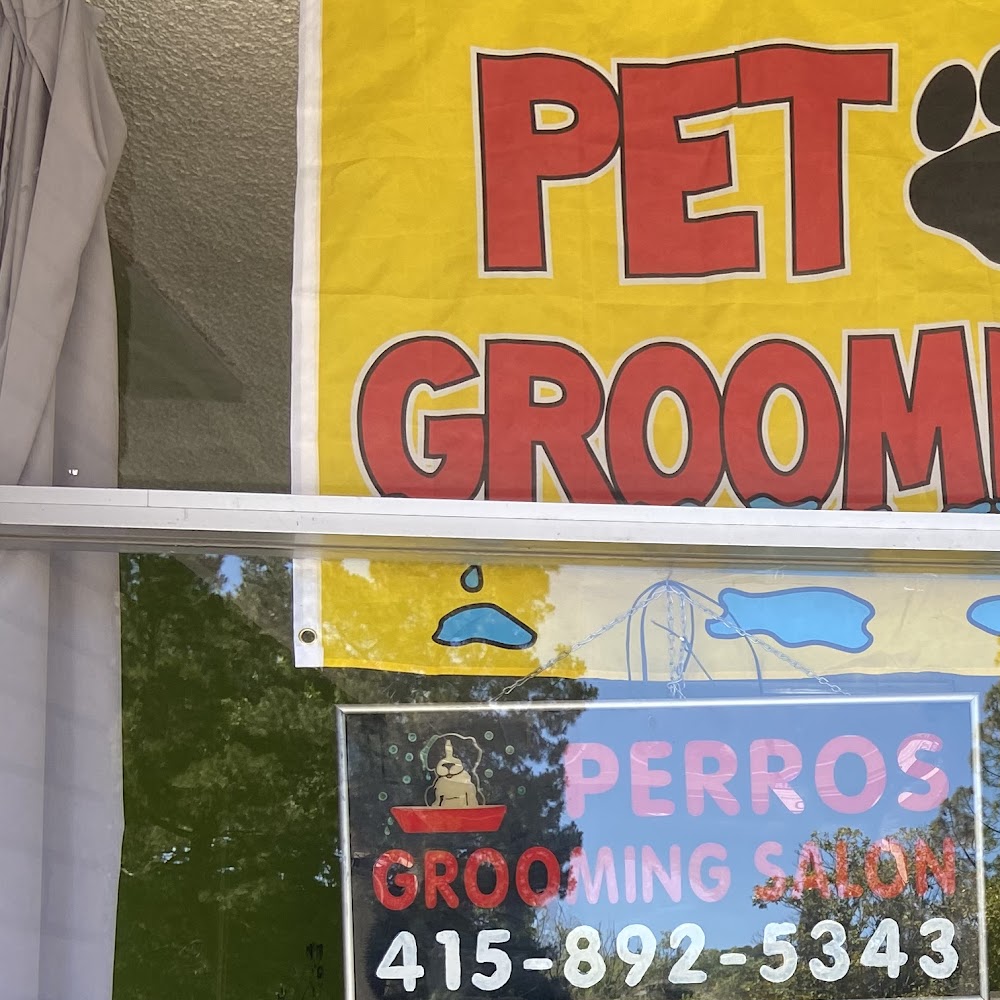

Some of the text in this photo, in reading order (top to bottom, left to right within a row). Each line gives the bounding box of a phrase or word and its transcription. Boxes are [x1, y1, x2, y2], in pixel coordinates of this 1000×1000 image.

[473, 44, 896, 283] PET
[562, 733, 951, 818] PERROS
[372, 837, 957, 911] GROOMING SALON
[375, 917, 959, 993] 415-892-5343
